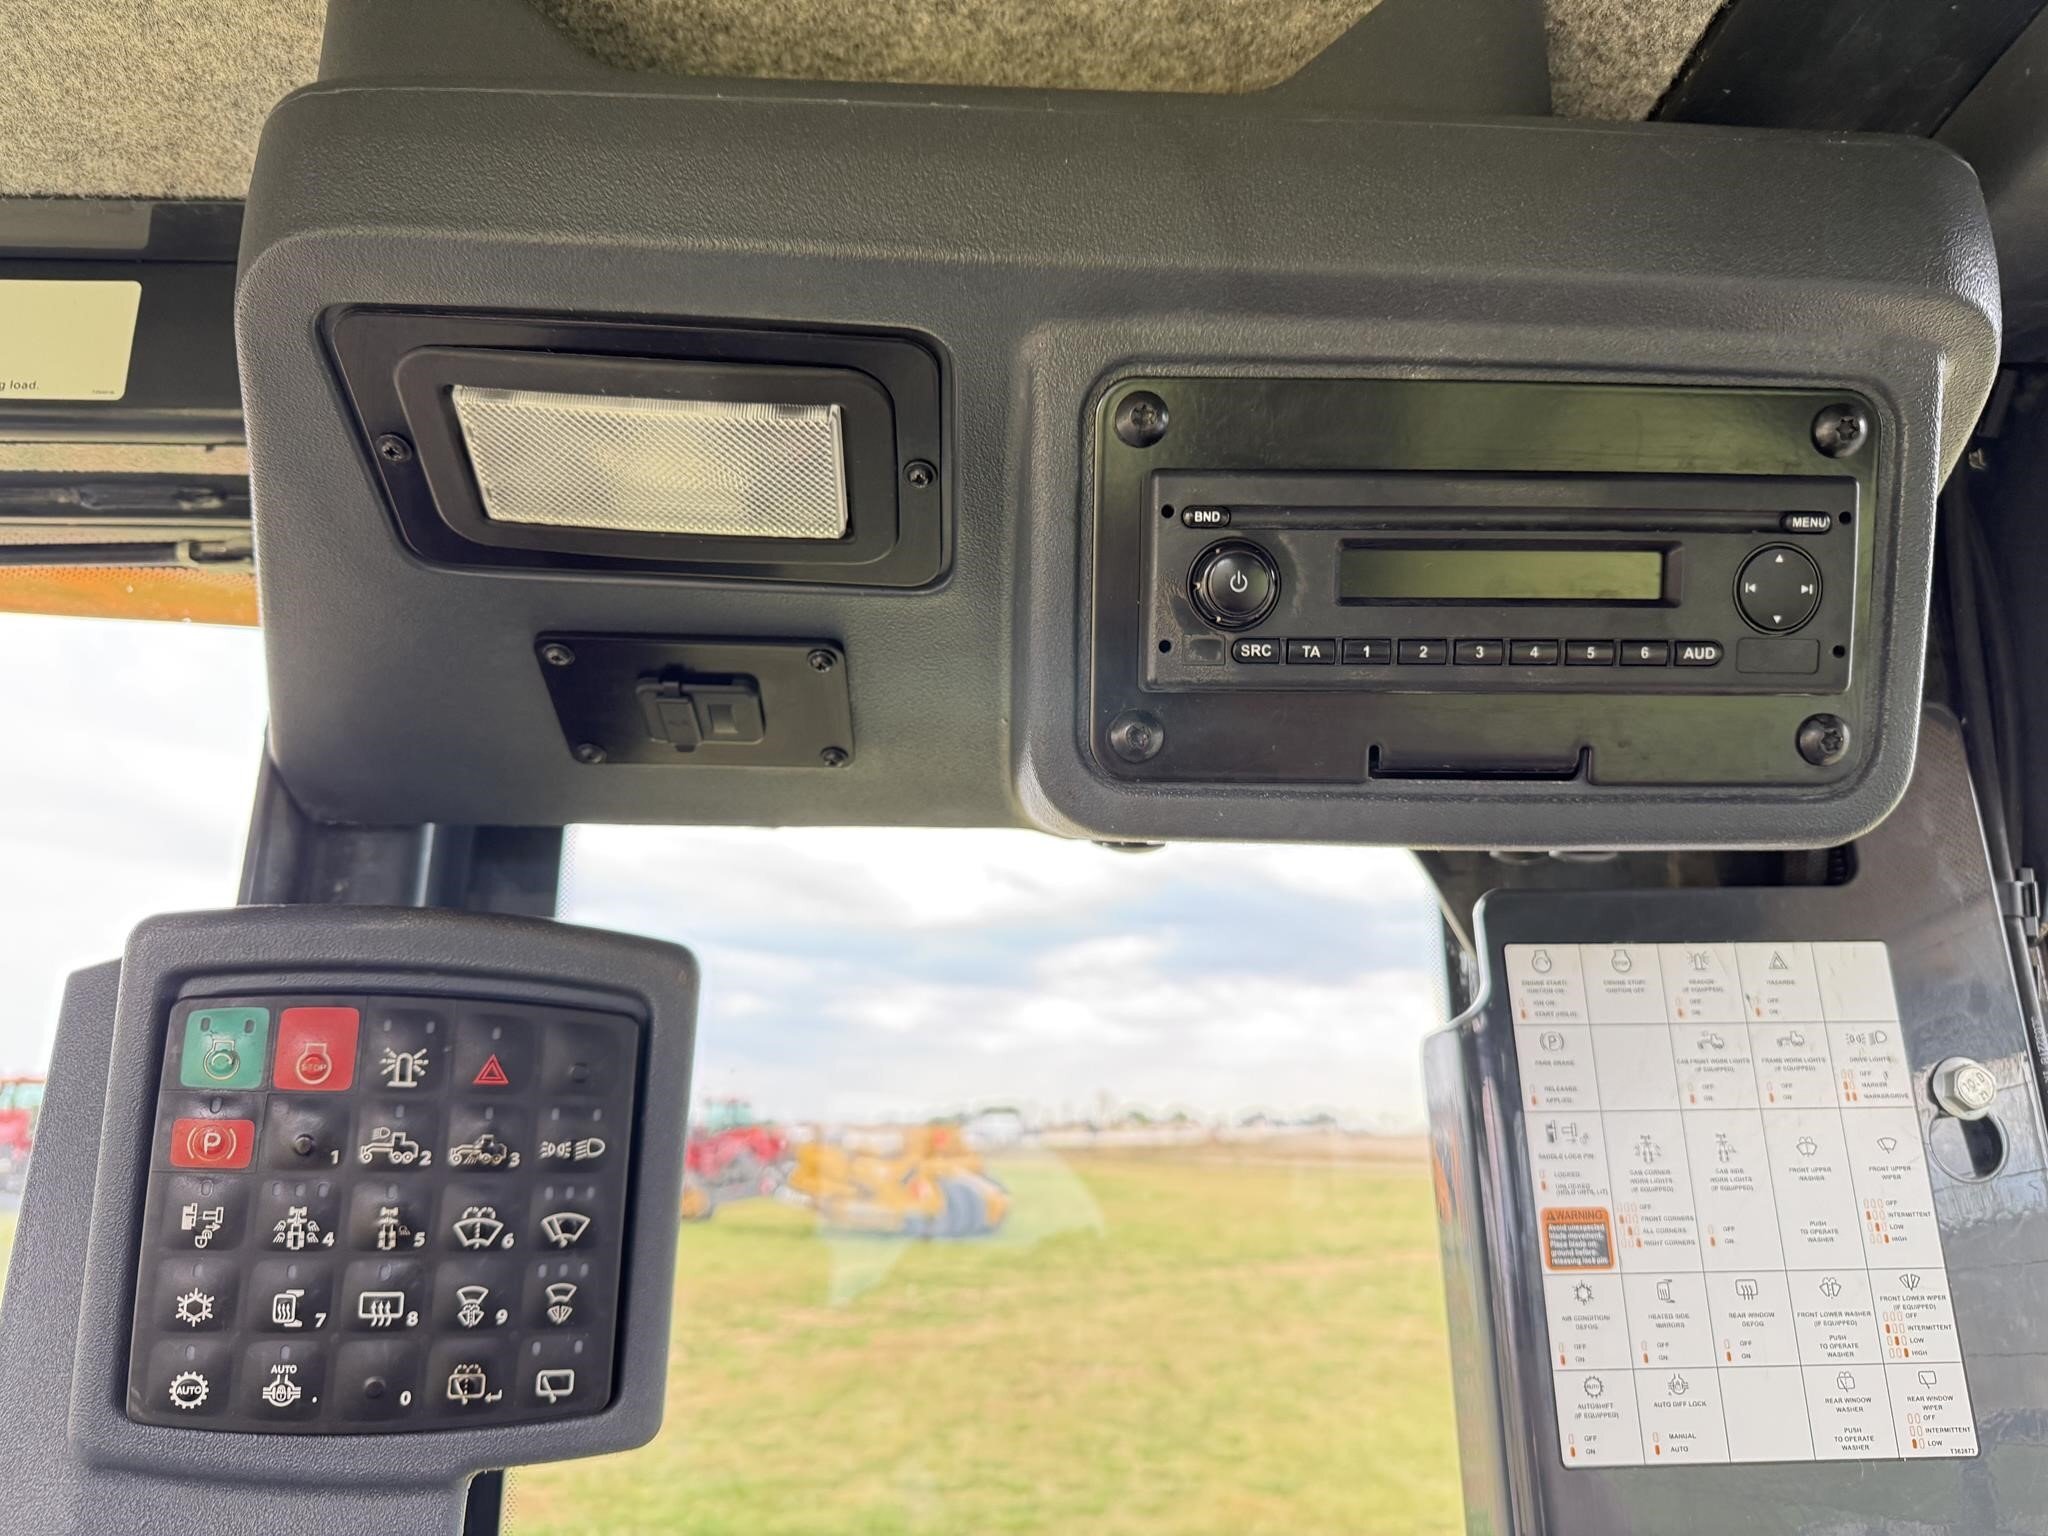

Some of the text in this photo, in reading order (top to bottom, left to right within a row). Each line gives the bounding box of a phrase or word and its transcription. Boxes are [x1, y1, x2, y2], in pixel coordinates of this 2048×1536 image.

[10, 380, 39, 391] load.
[1194, 510, 1221, 523] BND
[1792, 516, 1827, 528] MENU
[1240, 644, 1716, 660] SRC TA 1 2 3 4 5 6 AUD
[301, 1062, 328, 1072] STOP
[331, 1150, 340, 1165] 1
[419, 1150, 433, 1166] 2
[508, 1152, 521, 1168] 3
[1557, 1209, 1603, 1220] WARNING
[321, 1231, 335, 1247] 4
[413, 1231, 426, 1248] 5
[501, 1232, 515, 1249] 6
[315, 1312, 327, 1328] 7
[406, 1310, 419, 1327] 8
[496, 1308, 509, 1325] 9
[270, 1364, 298, 1374] AUTO
[176, 1385, 203, 1395] AUTO
[400, 1390, 412, 1406] 0
[1668, 1432, 1697, 1440] MANUAL
